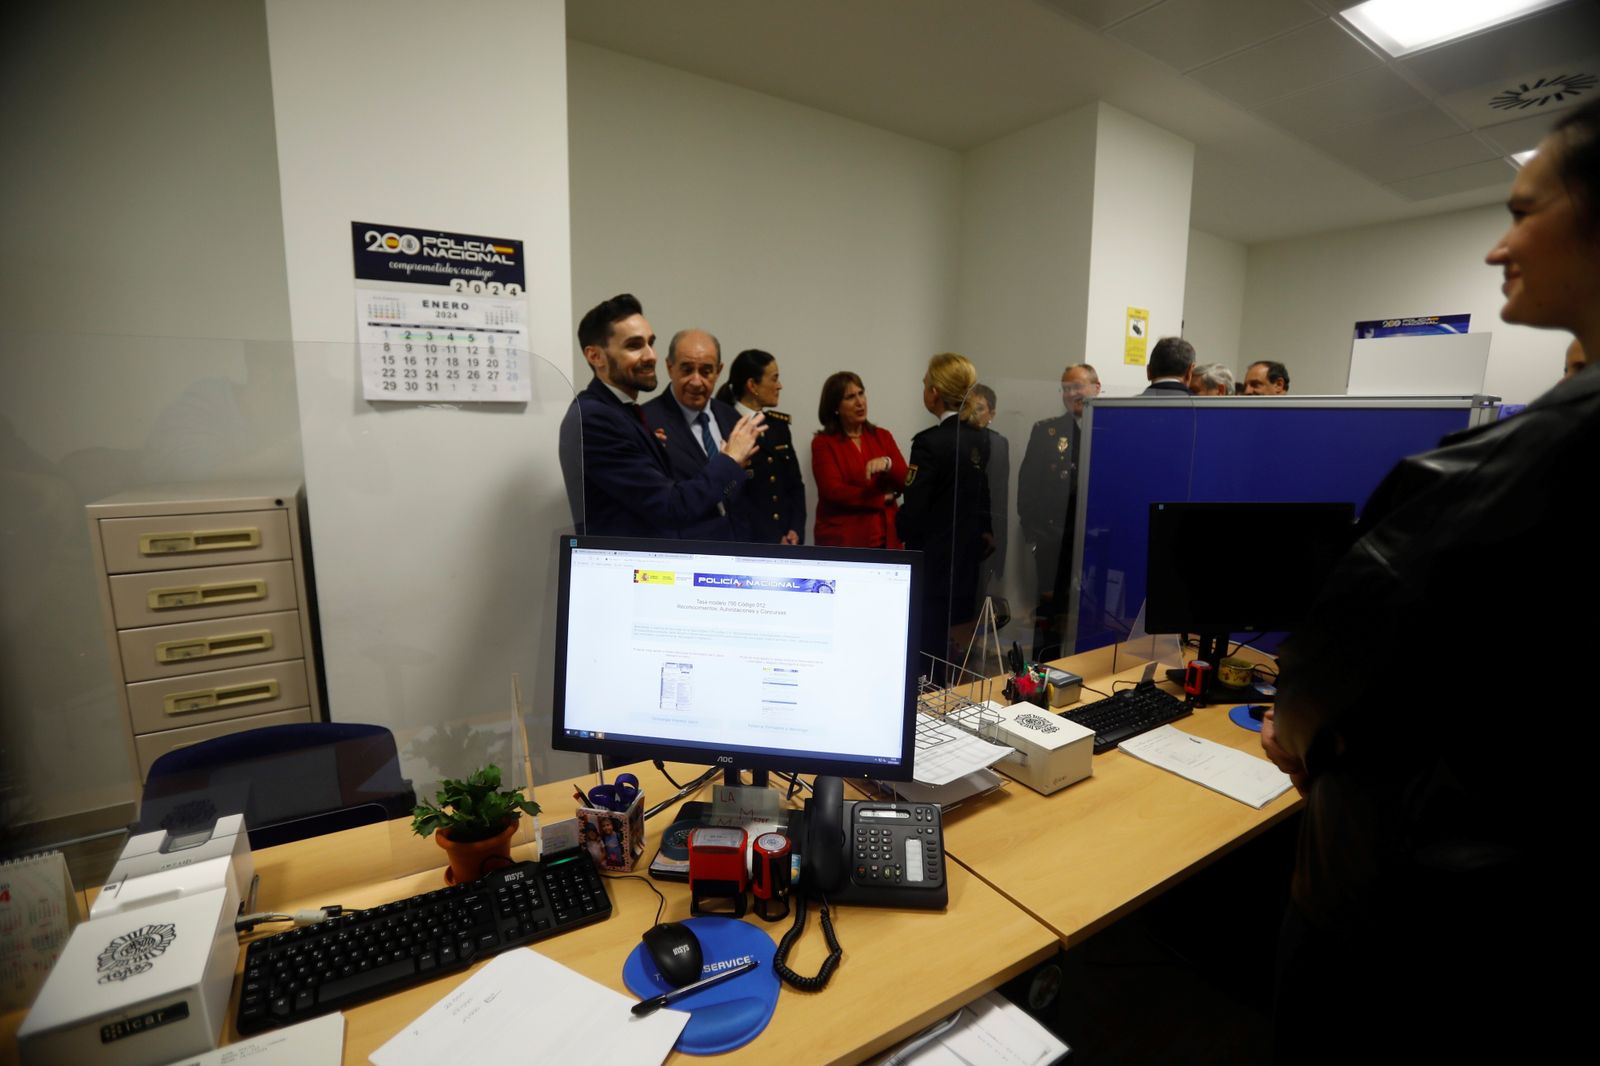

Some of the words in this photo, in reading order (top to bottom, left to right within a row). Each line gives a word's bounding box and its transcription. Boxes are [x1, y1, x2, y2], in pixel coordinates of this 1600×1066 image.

[364, 230, 420, 255] 200
[422, 236, 496, 253] POLICIA
[422, 247, 515, 266] NACIONAL
[388, 261, 459, 275] comprometidos
[460, 267, 496, 281] contigo
[422, 300, 469, 311] ENERO
[435, 311, 458, 319] 2024
[404, 330, 411, 340] 2
[426, 331, 433, 341] 3
[447, 333, 454, 341] 4
[467, 334, 475, 342] 5
[383, 342, 390, 352] 8
[404, 343, 412, 352] 9
[424, 344, 437, 353] 10
[445, 345, 456, 354] 11
[466, 345, 478, 355] 12
[382, 355, 395, 365] 15
[404, 356, 417, 365] 16
[424, 356, 437, 366] 17
[446, 357, 459, 367] 18
[467, 358, 479, 367] 19
[486, 358, 499, 368] 20
[382, 368, 395, 378] 22
[403, 368, 417, 378] 23
[425, 369, 439, 379] 24
[446, 369, 460, 379] 25
[467, 370, 480, 379] 26
[486, 370, 500, 380] 27
[383, 381, 397, 391] 29
[405, 381, 418, 391] 30
[426, 382, 438, 391] 31
[746, 579, 800, 589] NACIONAL
